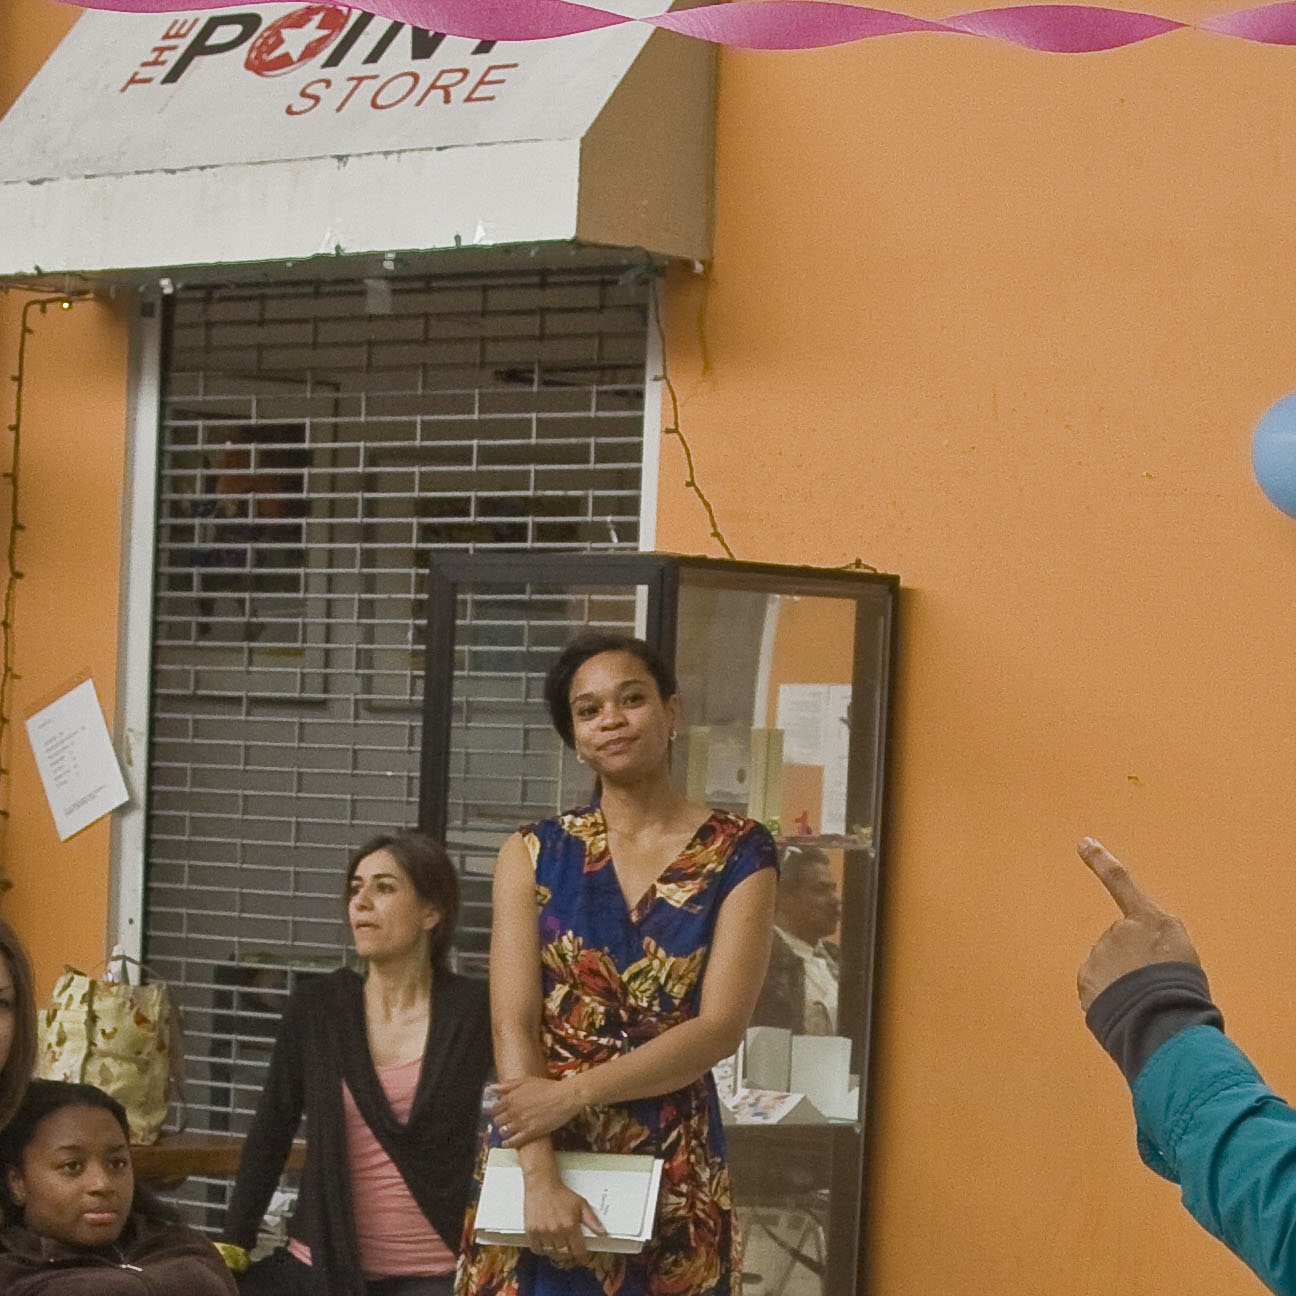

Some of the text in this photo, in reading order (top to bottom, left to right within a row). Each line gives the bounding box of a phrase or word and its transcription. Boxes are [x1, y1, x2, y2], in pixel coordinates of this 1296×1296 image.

[120, 16, 200, 93] THE
[160, 3, 498, 85] POIN
[285, 62, 519, 116] STORE
